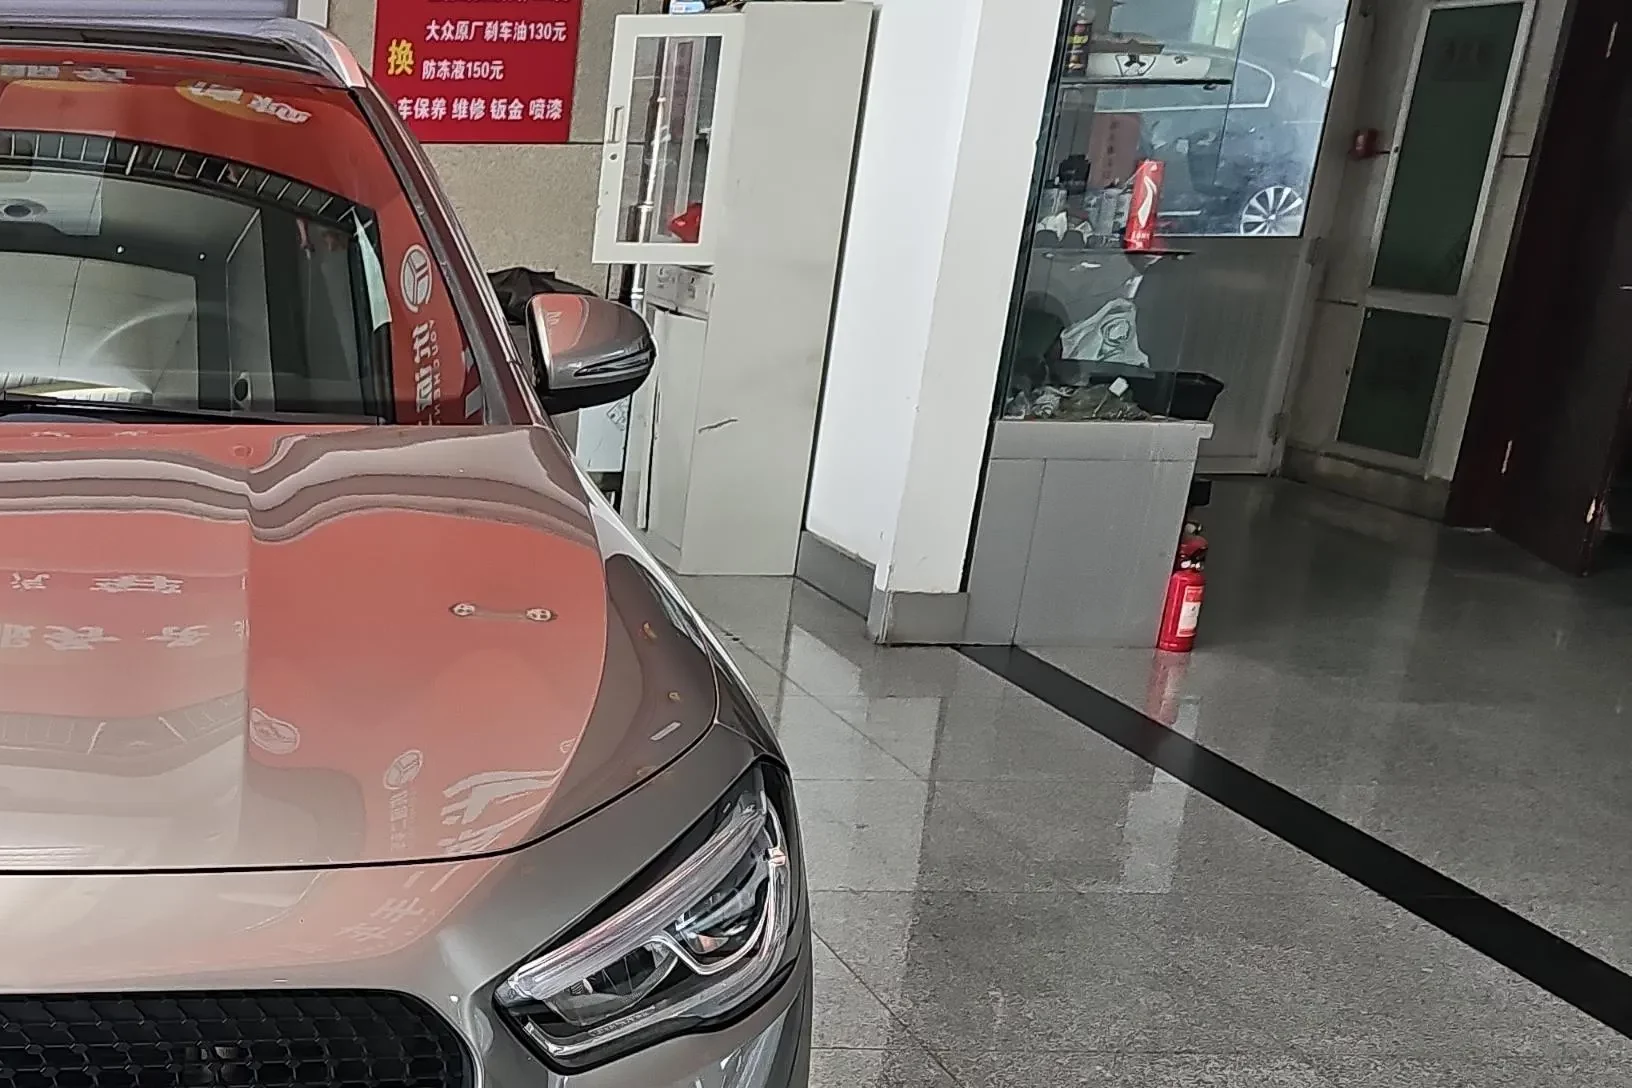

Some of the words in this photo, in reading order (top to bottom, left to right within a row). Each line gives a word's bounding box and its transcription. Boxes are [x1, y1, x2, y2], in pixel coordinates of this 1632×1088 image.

[425, 20, 567, 42] 大众原厂刹车油130元
[387, 39, 415, 76] 换
[421, 59, 505, 80] 防冻液150元
[394, 97, 447, 120] 车保养
[451, 97, 486, 121] 维修
[489, 98, 525, 121] 钣金
[528, 98, 564, 121] 喷漆
